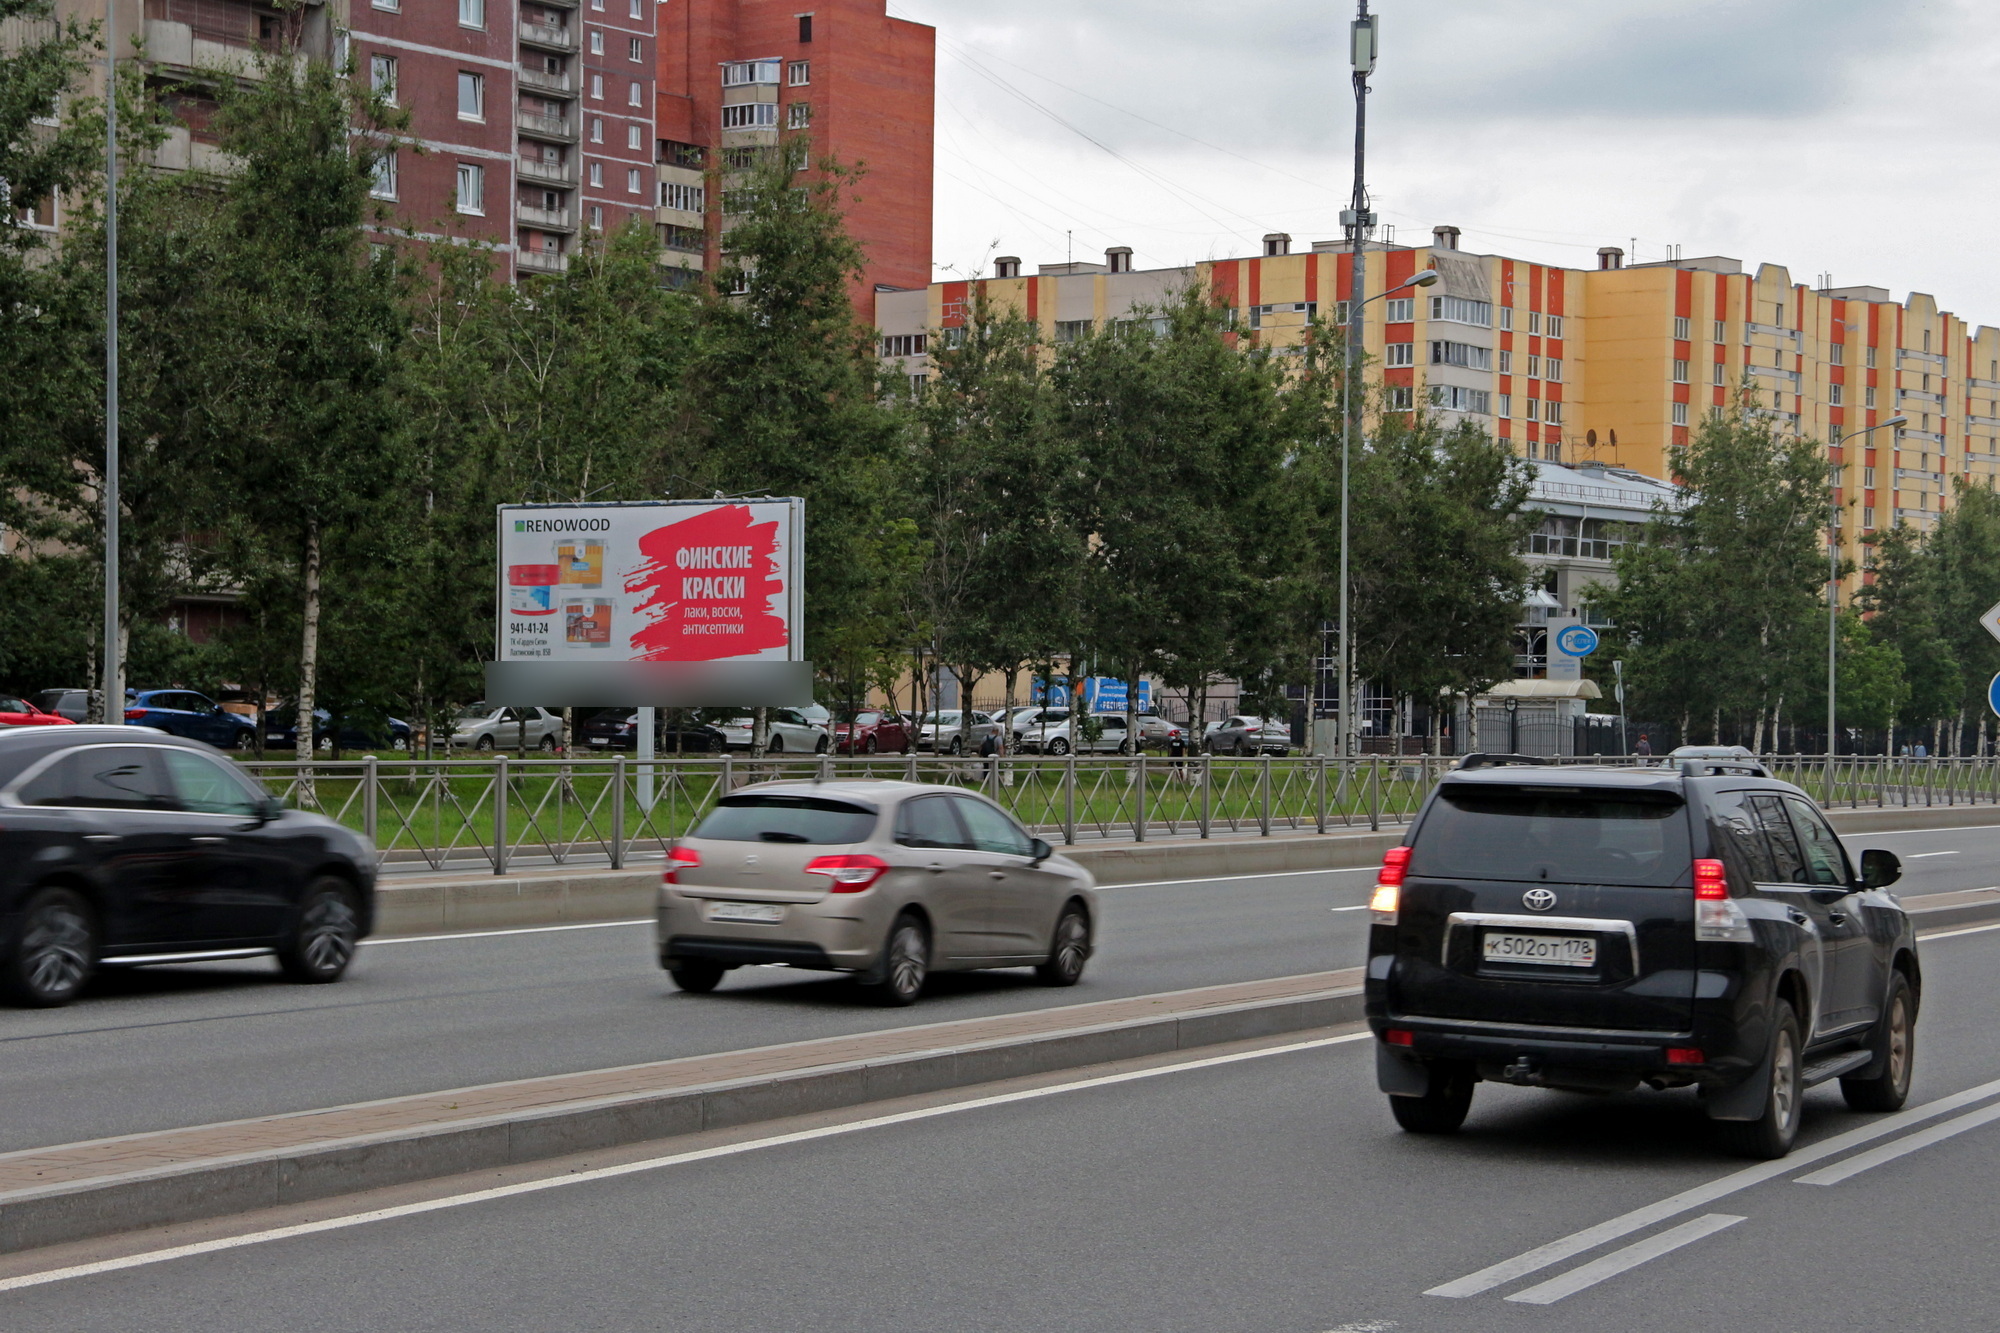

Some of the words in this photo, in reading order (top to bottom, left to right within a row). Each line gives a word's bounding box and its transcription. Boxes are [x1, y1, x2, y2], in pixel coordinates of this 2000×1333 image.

[526, 518, 610, 533] RENOWOOD
[675, 546, 752, 570] ФИНСКИЕ
[682, 576, 745, 600] КРАСКИ
[683, 607, 710, 620] лаки,
[711, 606, 743, 620] воски,
[510, 622, 549, 635] 941-41-24
[682, 623, 744, 635] антисептики
[1564, 940, 1590, 954] 178
